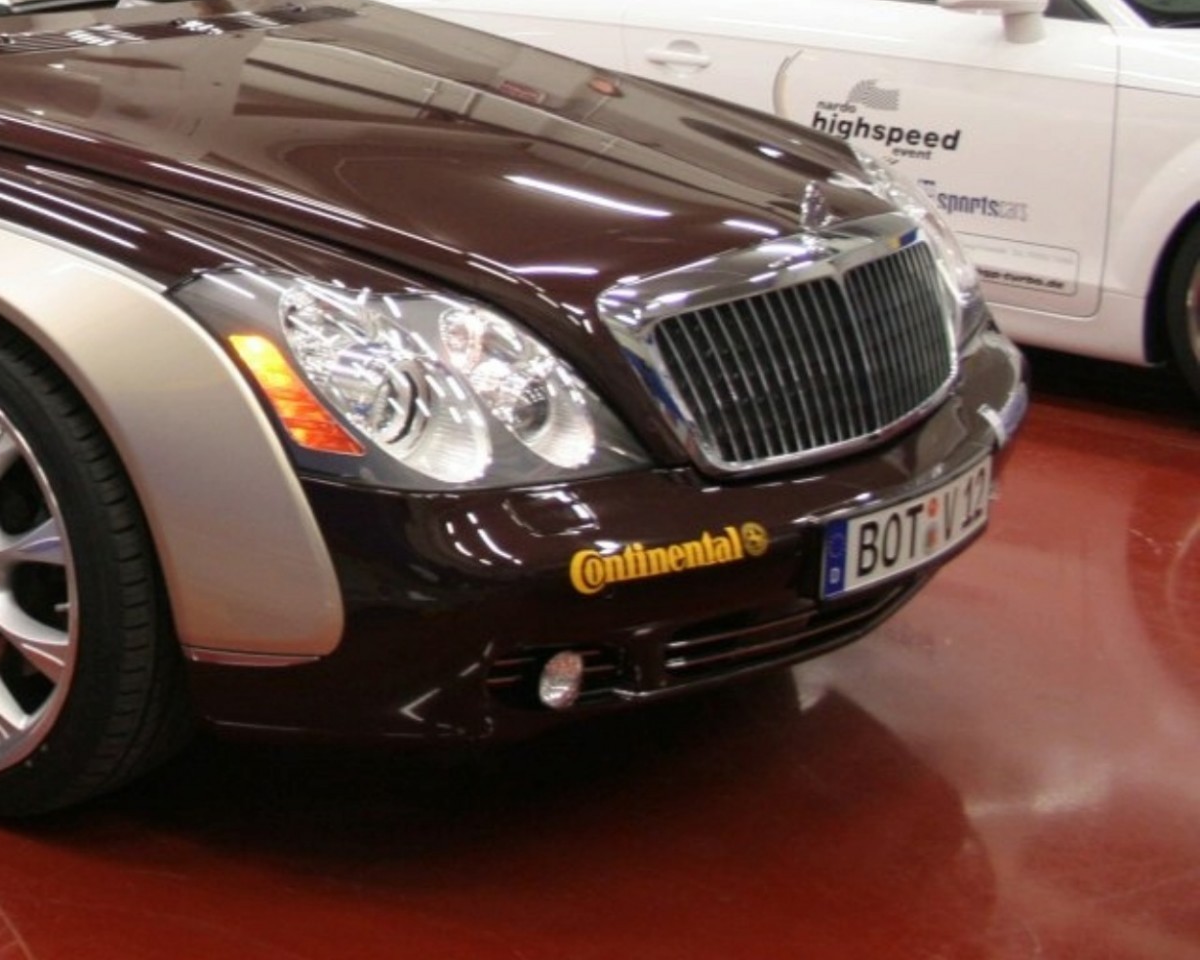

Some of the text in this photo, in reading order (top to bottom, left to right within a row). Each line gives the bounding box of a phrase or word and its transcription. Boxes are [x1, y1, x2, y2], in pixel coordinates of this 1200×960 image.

[816, 99, 857, 114] nardo
[811, 111, 961, 151] highspeed
[891, 146, 933, 161] event
[856, 467, 986, 577] BOT V 12
[569, 526, 745, 595] Continental
